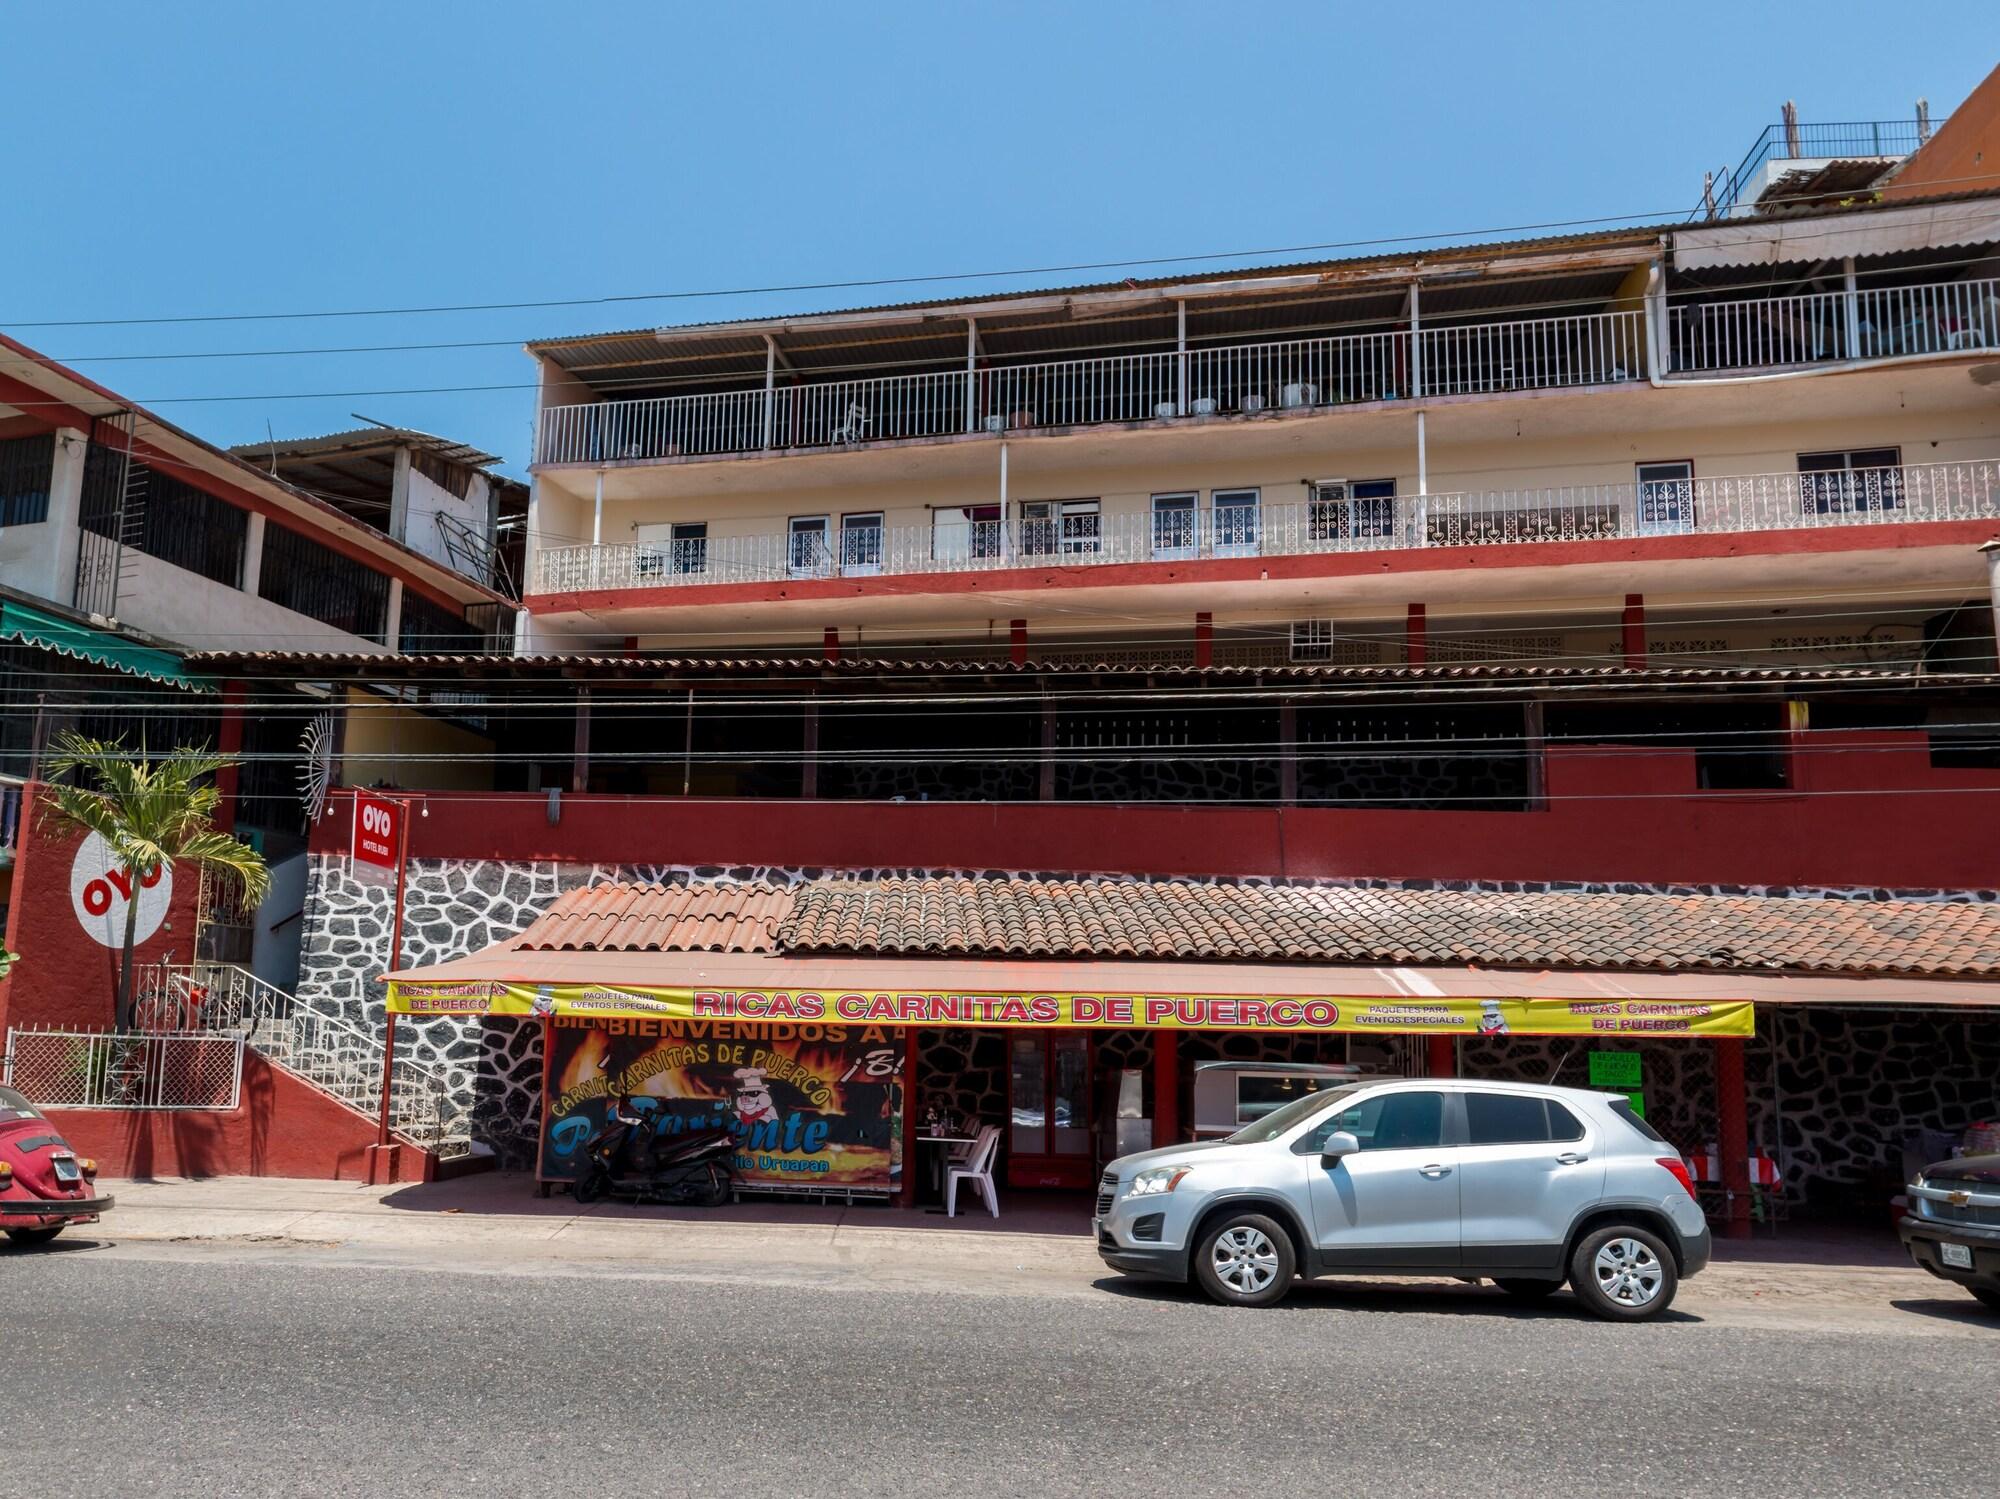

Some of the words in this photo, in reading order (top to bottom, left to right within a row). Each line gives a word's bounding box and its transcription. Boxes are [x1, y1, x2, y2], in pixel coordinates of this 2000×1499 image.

[363, 804, 391, 838] OYO
[362, 839, 378, 852] HOTEL
[438, 985, 508, 996] CARNITAS
[583, 992, 630, 1001] PAQUETES
[410, 999, 429, 1010] DE
[431, 999, 489, 1010] PUERCO
[570, 1001, 612, 1010] EVENTOS
[613, 1002, 669, 1012] ESPECIALES
[692, 991, 826, 1019] RICAS
[836, 993, 1060, 1023] CARNITAS
[1071, 996, 1134, 1024] DE
[1145, 997, 1339, 1027] PUERCO
[1369, 1005, 1422, 1014] PAQUETES
[1423, 1006, 1449, 1014] PARA
[1569, 1003, 1622, 1015] RICAS
[1626, 1004, 1712, 1016] CARNITAS
[1355, 1015, 1402, 1025] EVENTOS
[1403, 1016, 1465, 1025] ESPECIALES
[1592, 1019, 1617, 1031] DE
[1620, 1019, 1691, 1031] PUERCO
[607, 1018, 849, 1044] BIENVENIDOS
[859, 1022, 888, 1044] A
[607, 1043, 709, 1098] CARNITAS
[717, 1042, 745, 1066] DE
[751, 1047, 832, 1106] PUERCO
[758, 1155, 830, 1173] Uruapan
